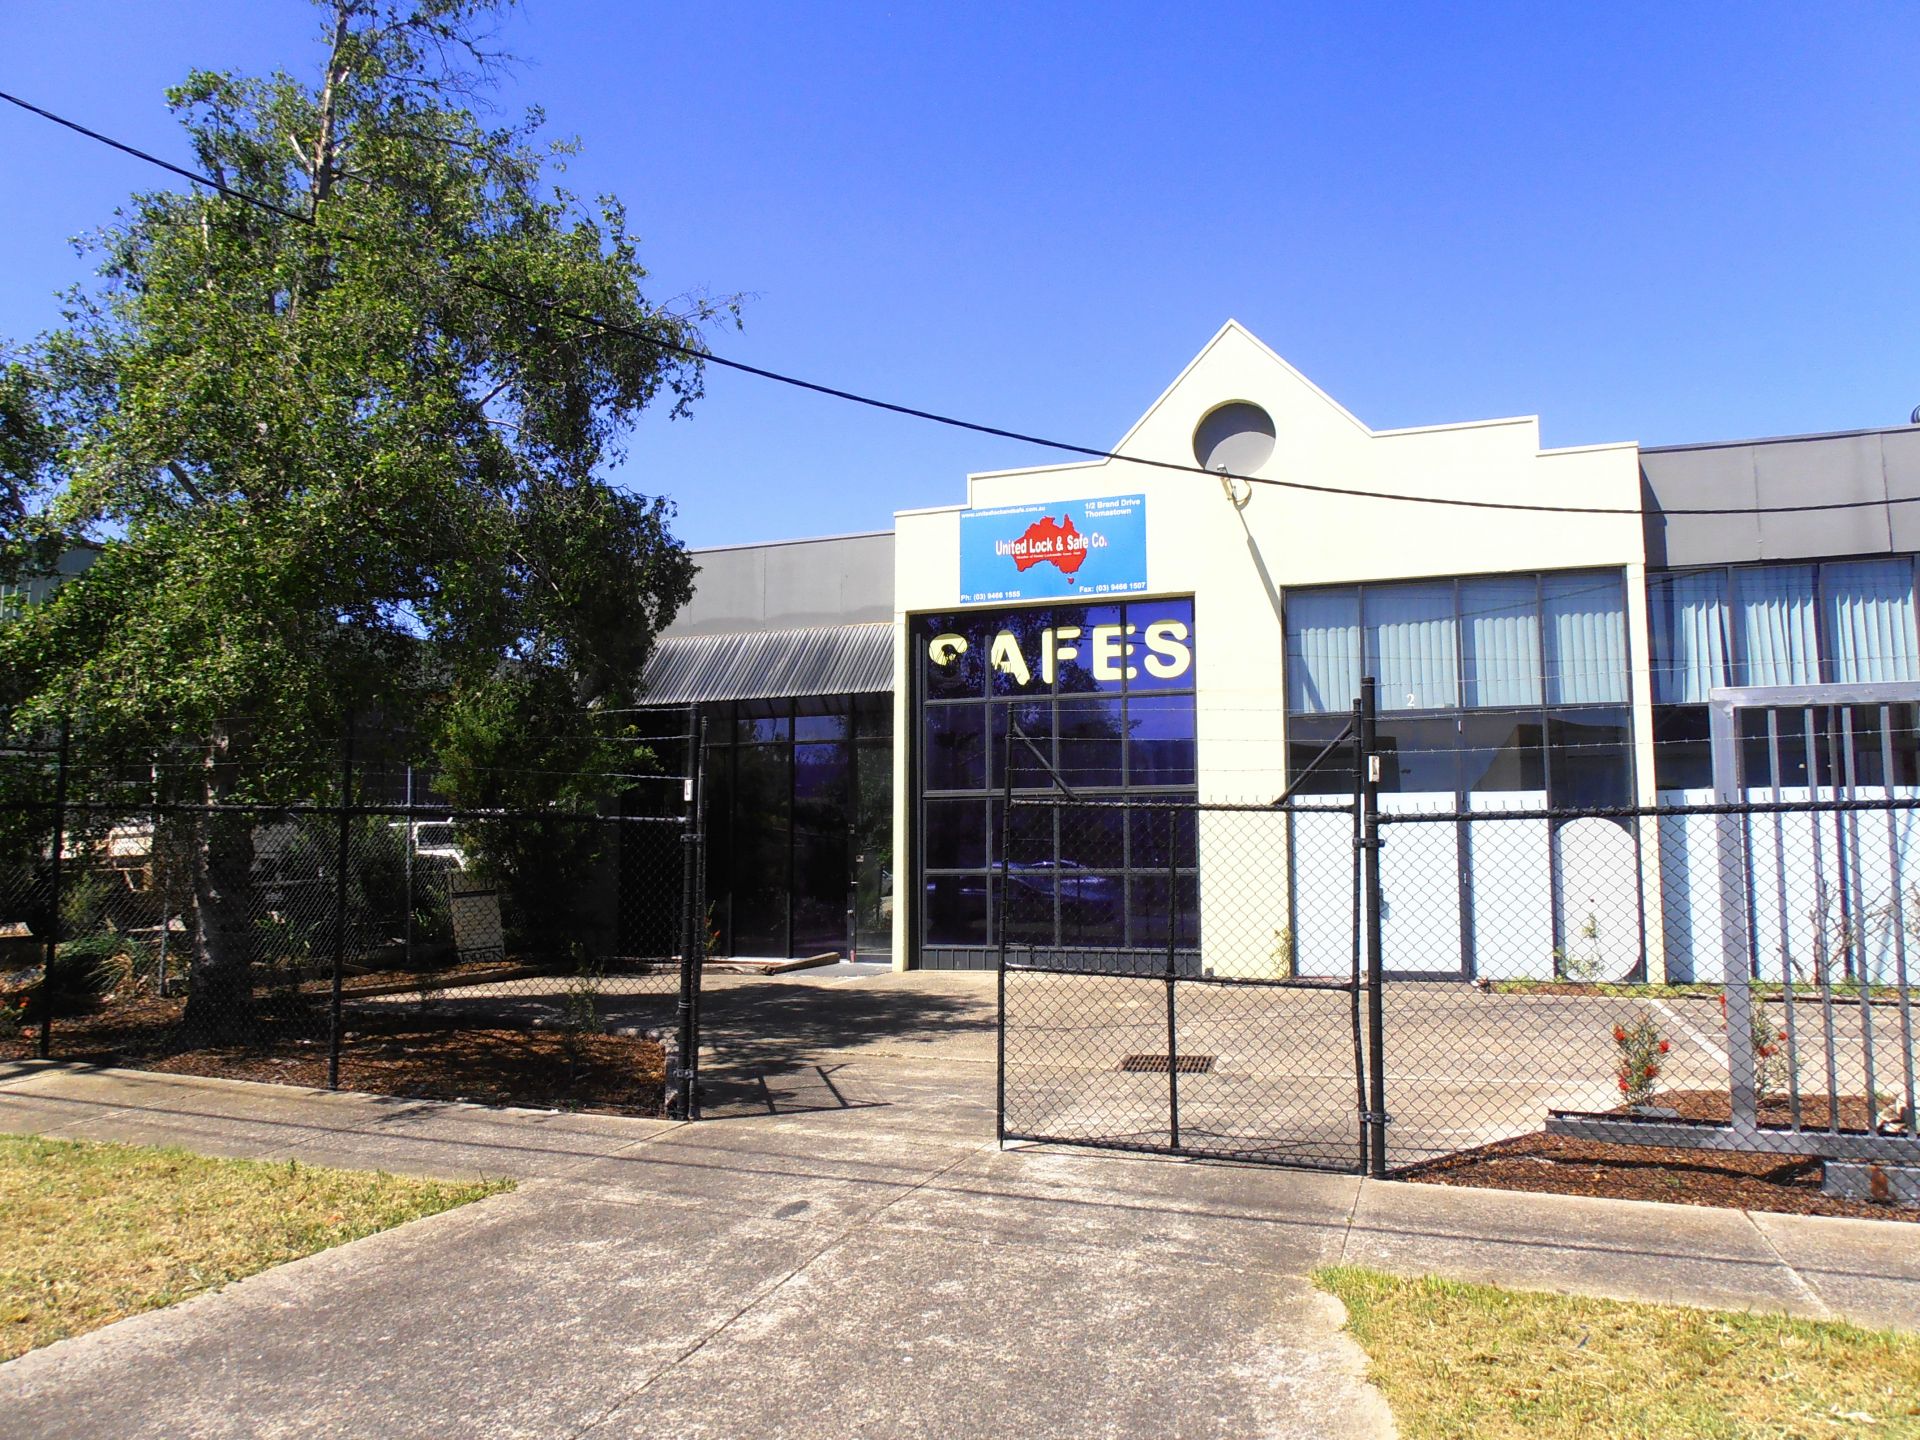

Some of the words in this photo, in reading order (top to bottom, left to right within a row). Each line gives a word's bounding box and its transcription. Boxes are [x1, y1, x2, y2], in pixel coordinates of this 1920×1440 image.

[1121, 498, 1141, 507] Drive
[1085, 508, 1132, 518] Thomastown
[995, 539, 1027, 556] United
[1030, 538, 1053, 554] Lock
[1055, 536, 1064, 551] &
[1067, 534, 1088, 551] Safe
[1091, 532, 1108, 548] Co.
[1095, 584, 1109, 593] (03)
[973, 593, 986, 601] (03)
[1407, 693, 1415, 707] 2
